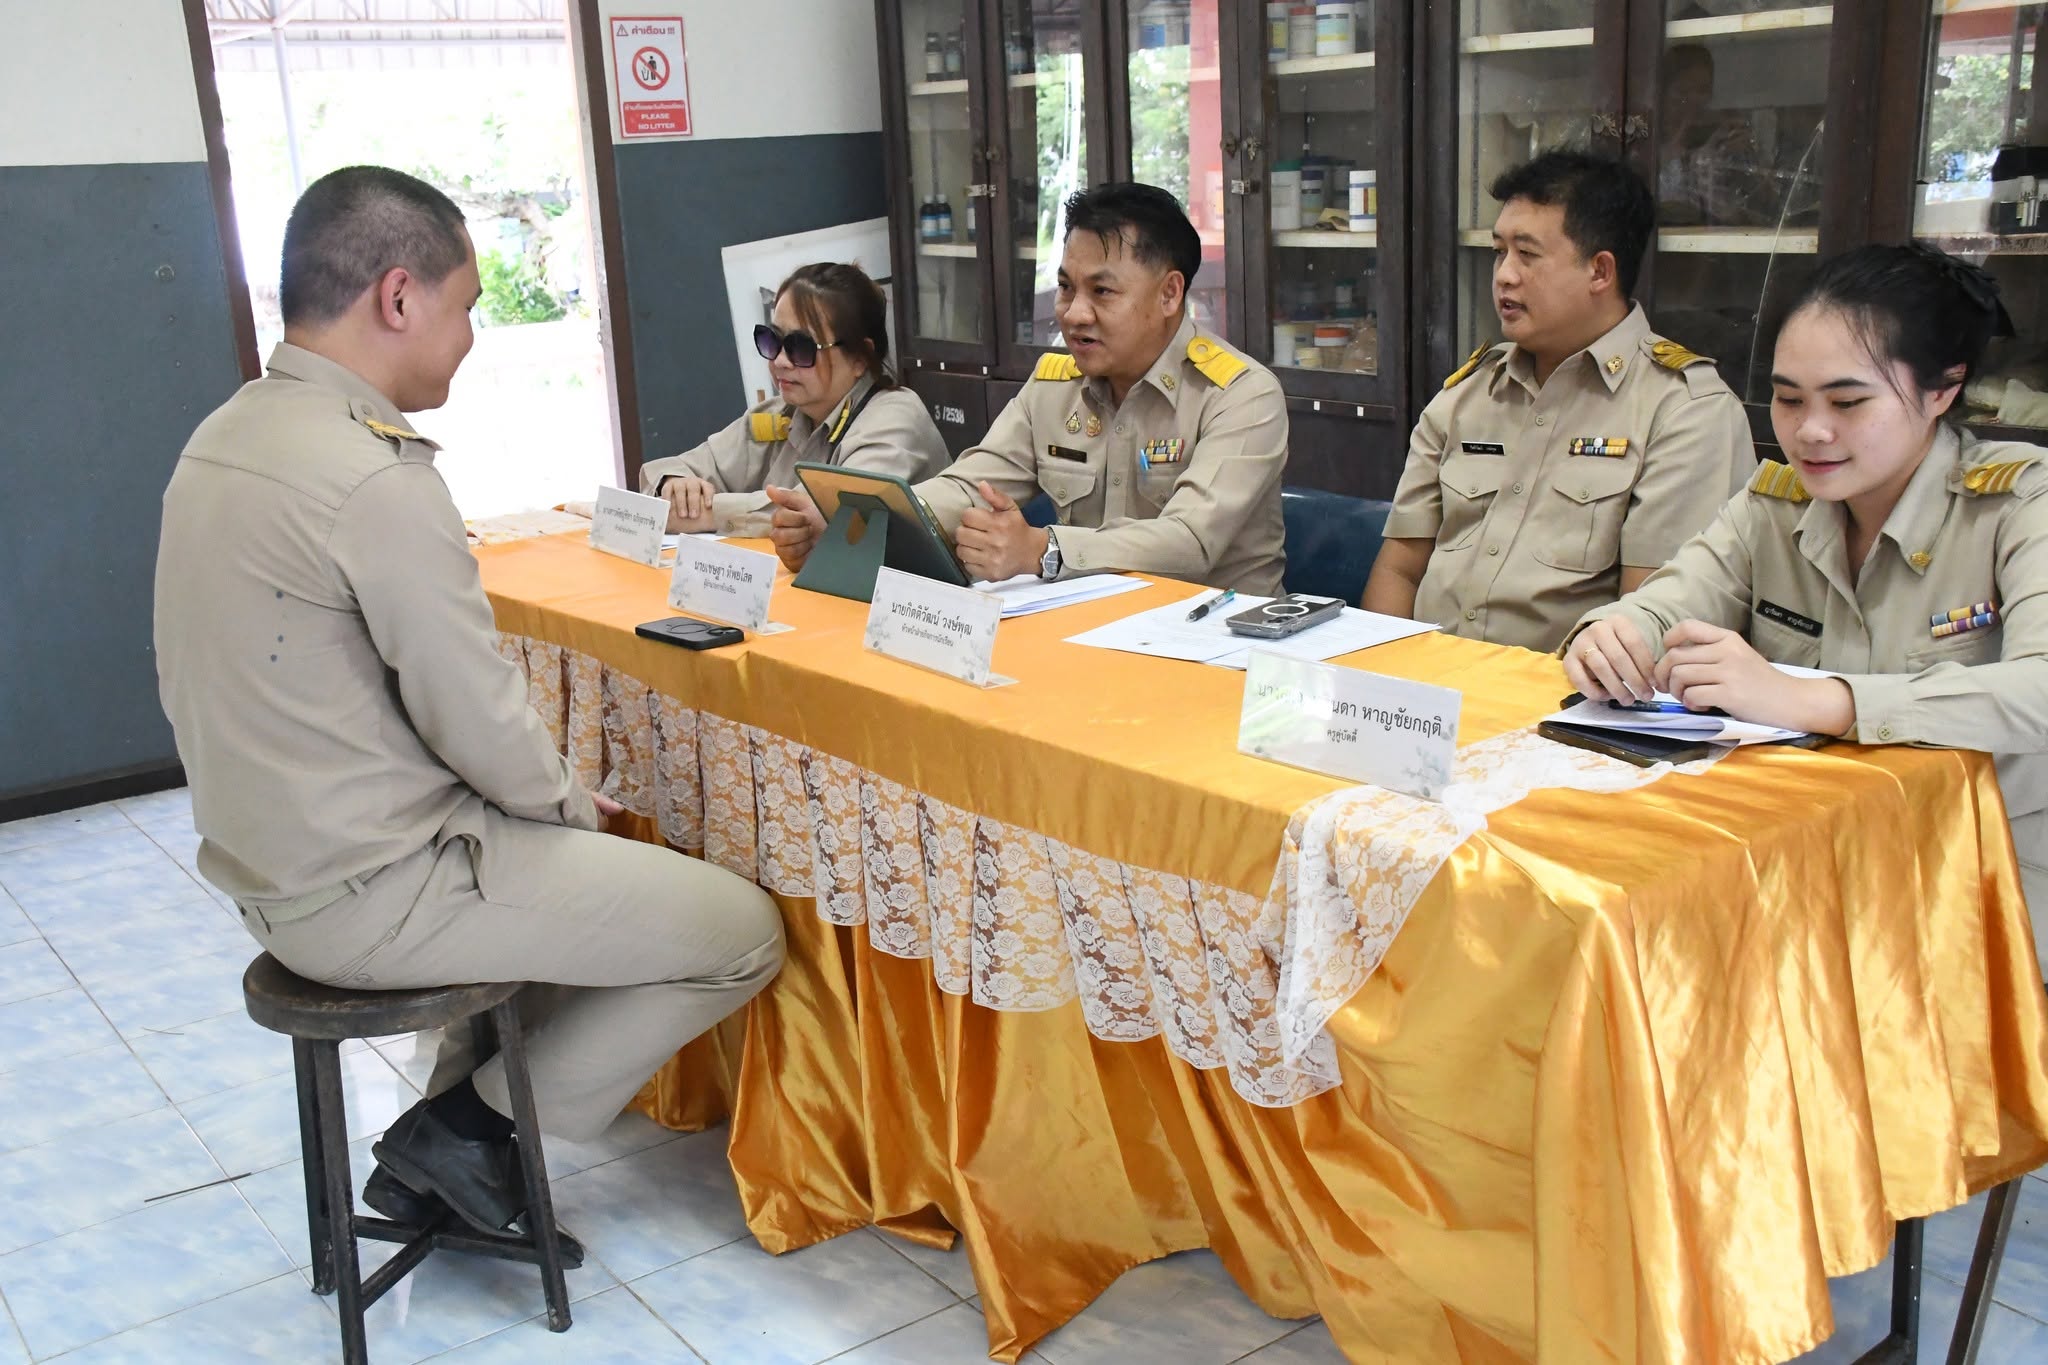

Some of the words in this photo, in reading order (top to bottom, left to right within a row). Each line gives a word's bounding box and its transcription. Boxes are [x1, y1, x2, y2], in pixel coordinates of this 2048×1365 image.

[631, 25, 666, 35] คำเตือน
[891, 601, 941, 626] นายกิตติวัฒน์
[1362, 706, 1442, 738] หาญชัยกฤติ
